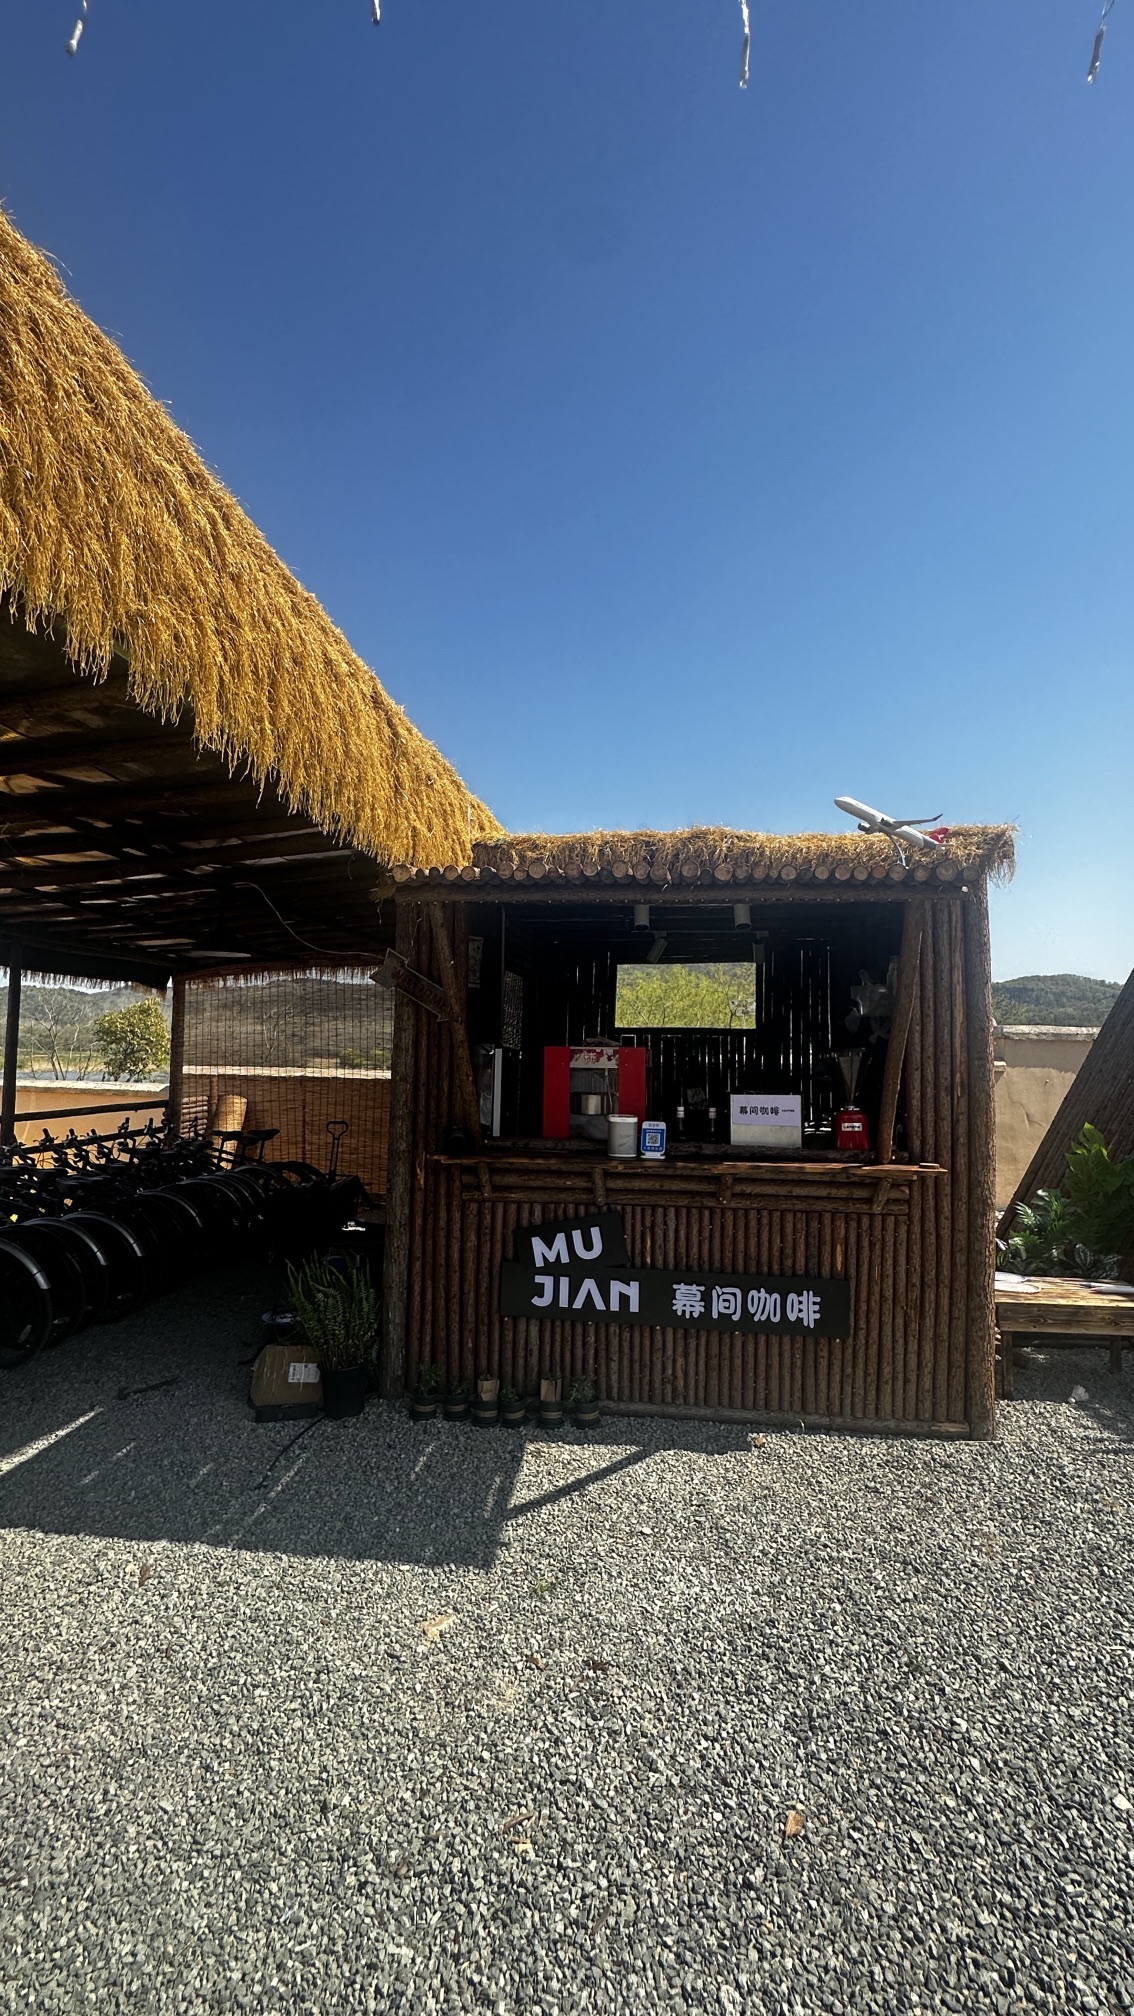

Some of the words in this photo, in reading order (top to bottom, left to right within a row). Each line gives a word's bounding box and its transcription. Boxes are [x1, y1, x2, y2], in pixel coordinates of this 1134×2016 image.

[739, 1105, 780, 1116] 幕间咖啡
[531, 1226, 604, 1268] MU
[531, 1274, 640, 1313] JIAN
[672, 1282, 822, 1329] 幕间咖啡
